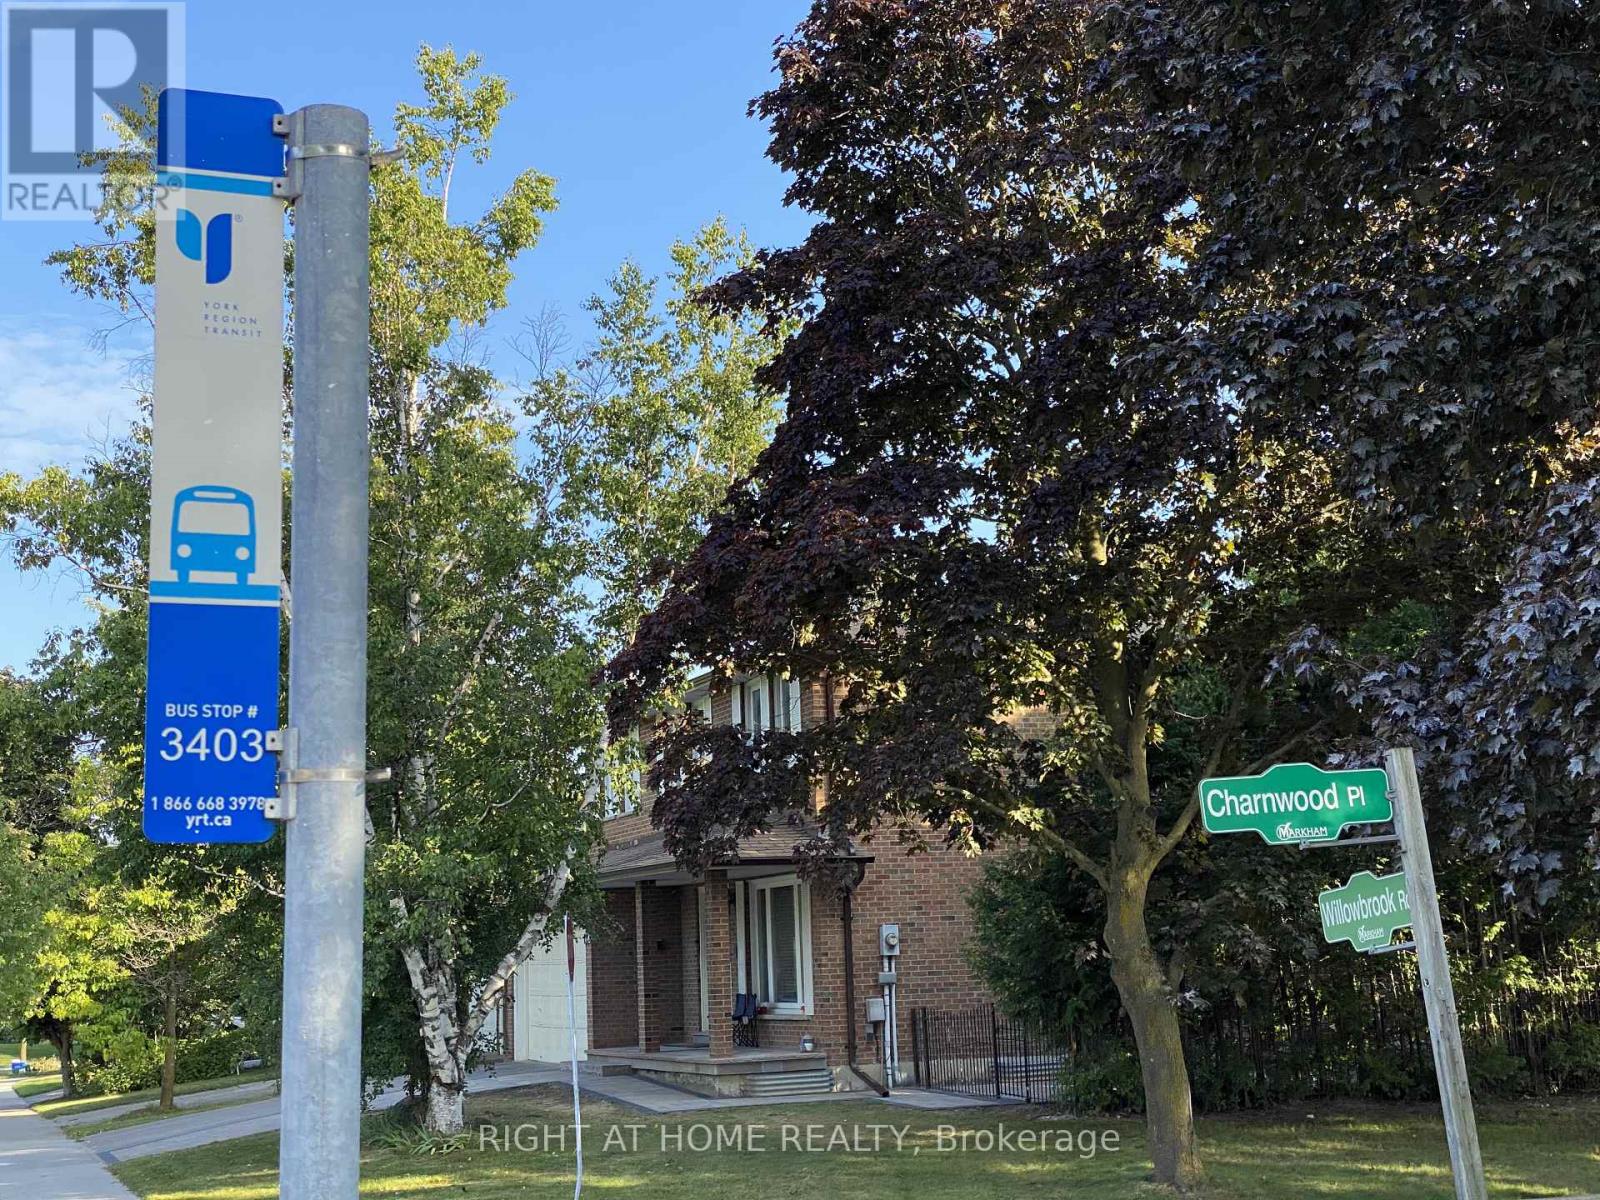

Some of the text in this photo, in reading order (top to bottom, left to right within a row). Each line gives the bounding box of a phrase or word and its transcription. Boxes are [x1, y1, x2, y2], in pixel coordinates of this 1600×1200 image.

[203, 300, 240, 311] YORK
[204, 313, 257, 324] REGION
[204, 326, 262, 337] TRANSIT
[165, 703, 258, 718] BUS STOP #
[160, 727, 264, 762] 3403
[151, 796, 265, 811] 1 866 668 3978
[1206, 782, 1366, 818] Charnwood Pl
[185, 813, 232, 829] yrt.ca
[1276, 822, 1328, 840] MARKHAM
[1321, 887, 1396, 927] Willowbrook
